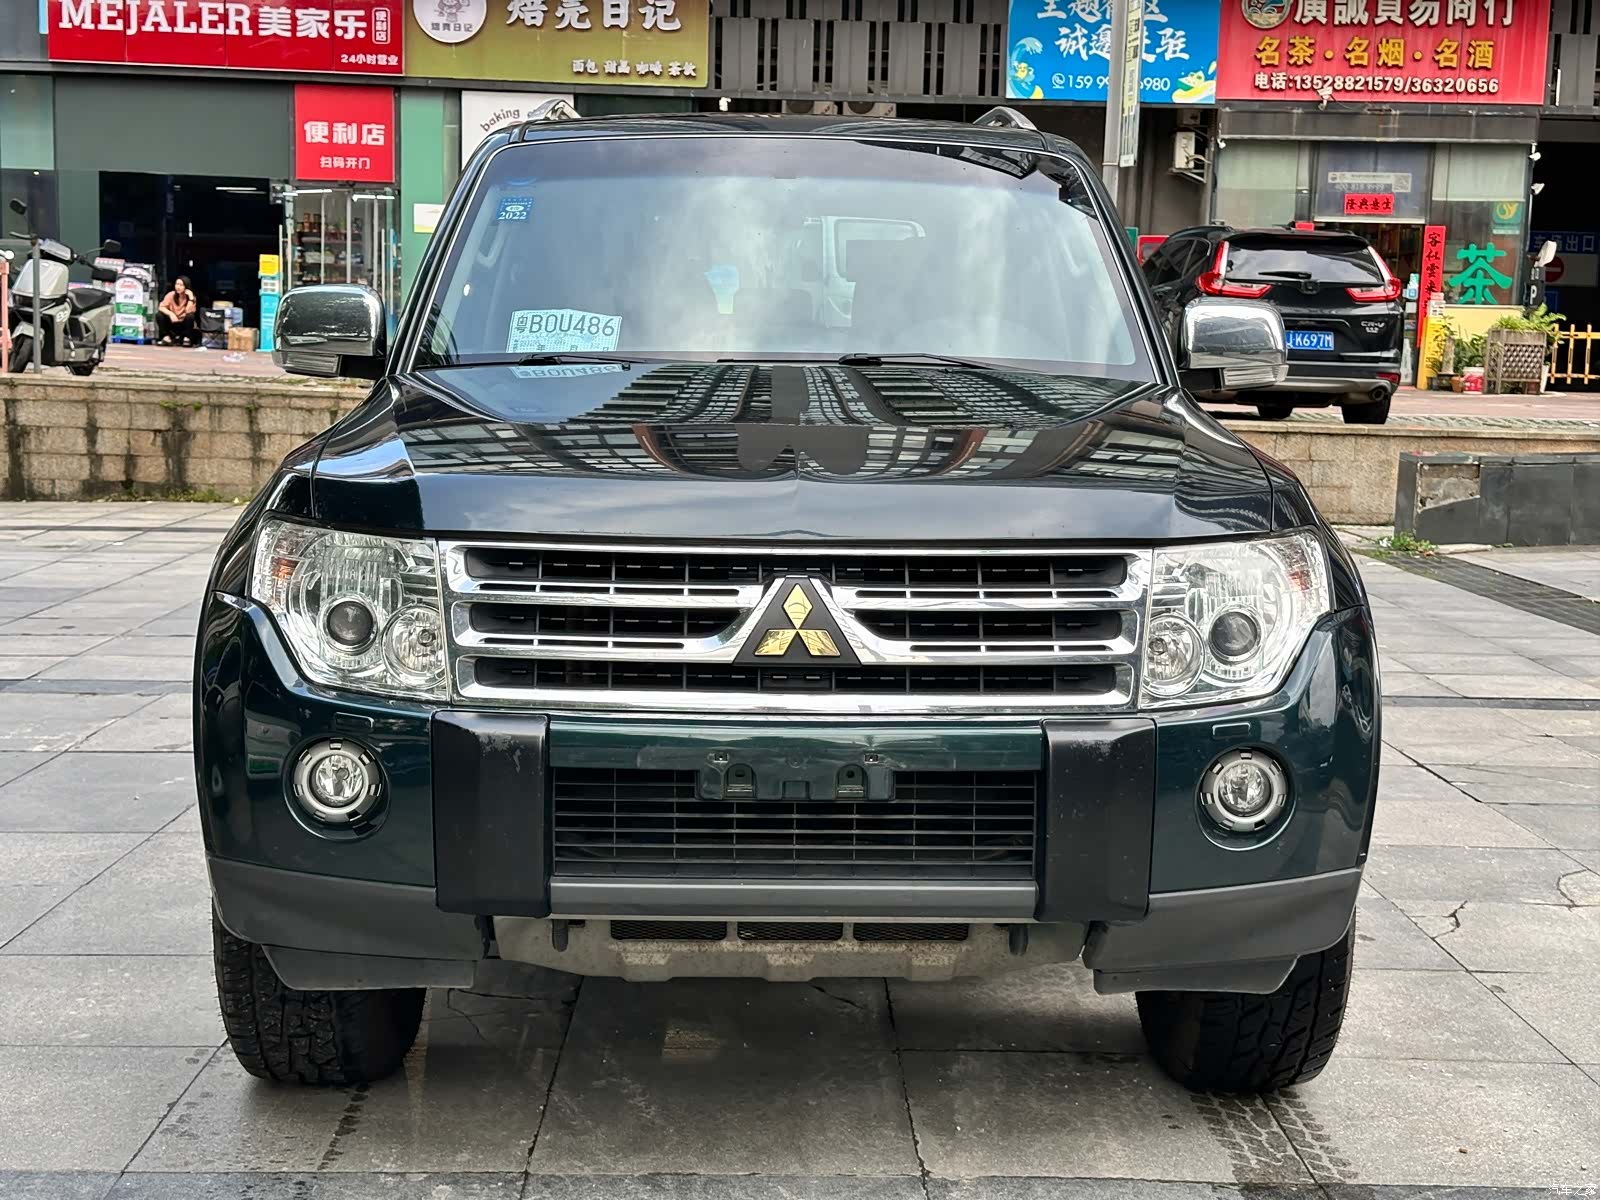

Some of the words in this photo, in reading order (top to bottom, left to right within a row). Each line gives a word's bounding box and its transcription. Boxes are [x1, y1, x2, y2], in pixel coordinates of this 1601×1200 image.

[258, 6, 367, 39] 美家乐
[340, 53, 399, 65] 24小时营业
[572, 59, 598, 74] 面包
[635, 61, 662, 75] 咖啡
[668, 61, 696, 76] 茶饮
[480, 109, 520, 132] baking
[303, 121, 386, 146] 便利店
[319, 156, 371, 170] 扫码开门
[498, 211, 527, 220] 2022
[1449, 242, 1513, 304] 茶
